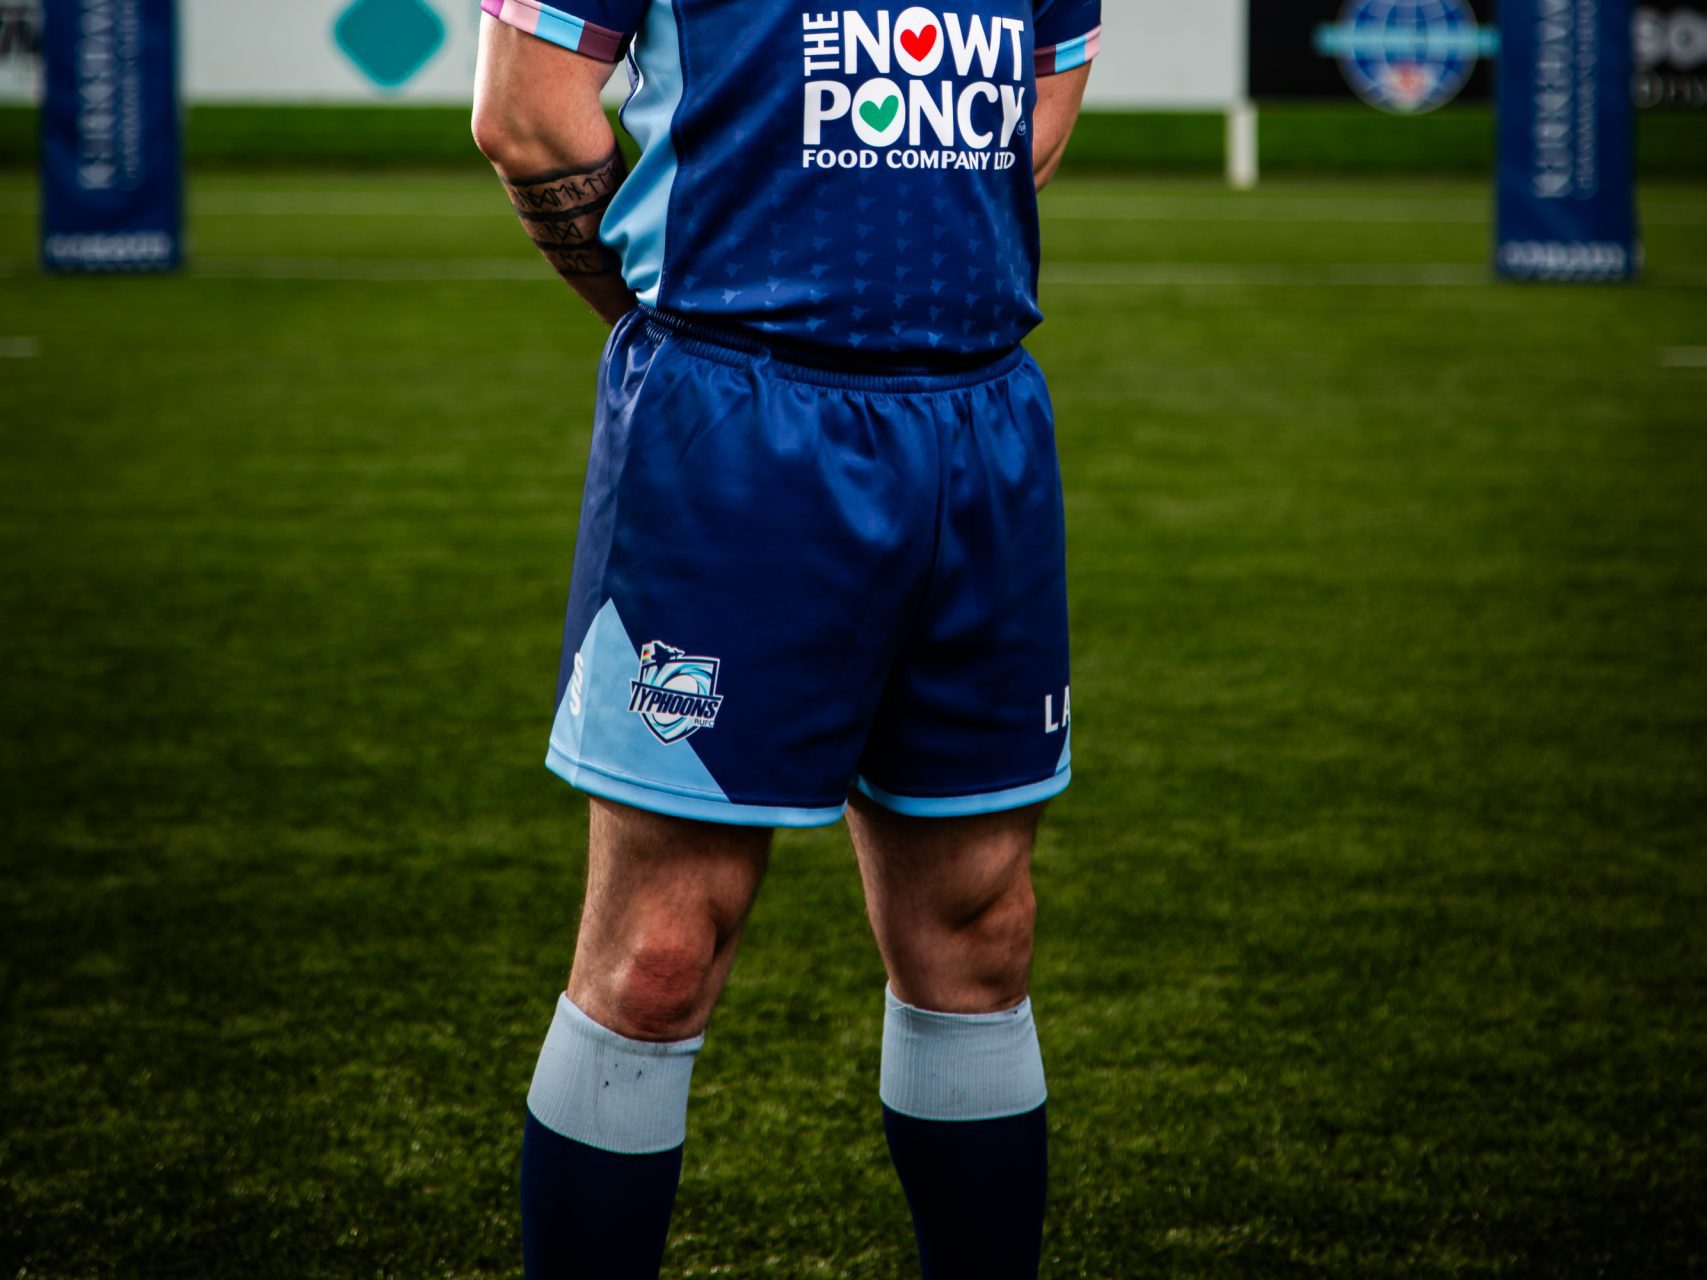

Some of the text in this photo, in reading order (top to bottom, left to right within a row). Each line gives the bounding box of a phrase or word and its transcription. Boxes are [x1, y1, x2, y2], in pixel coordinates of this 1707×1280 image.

[802, 6, 1024, 81] THE NOWT
[803, 77, 1025, 149] PONCY
[802, 149, 1016, 170] FOOD COMPANY LTD
[631, 681, 722, 719] TYPHOONS
